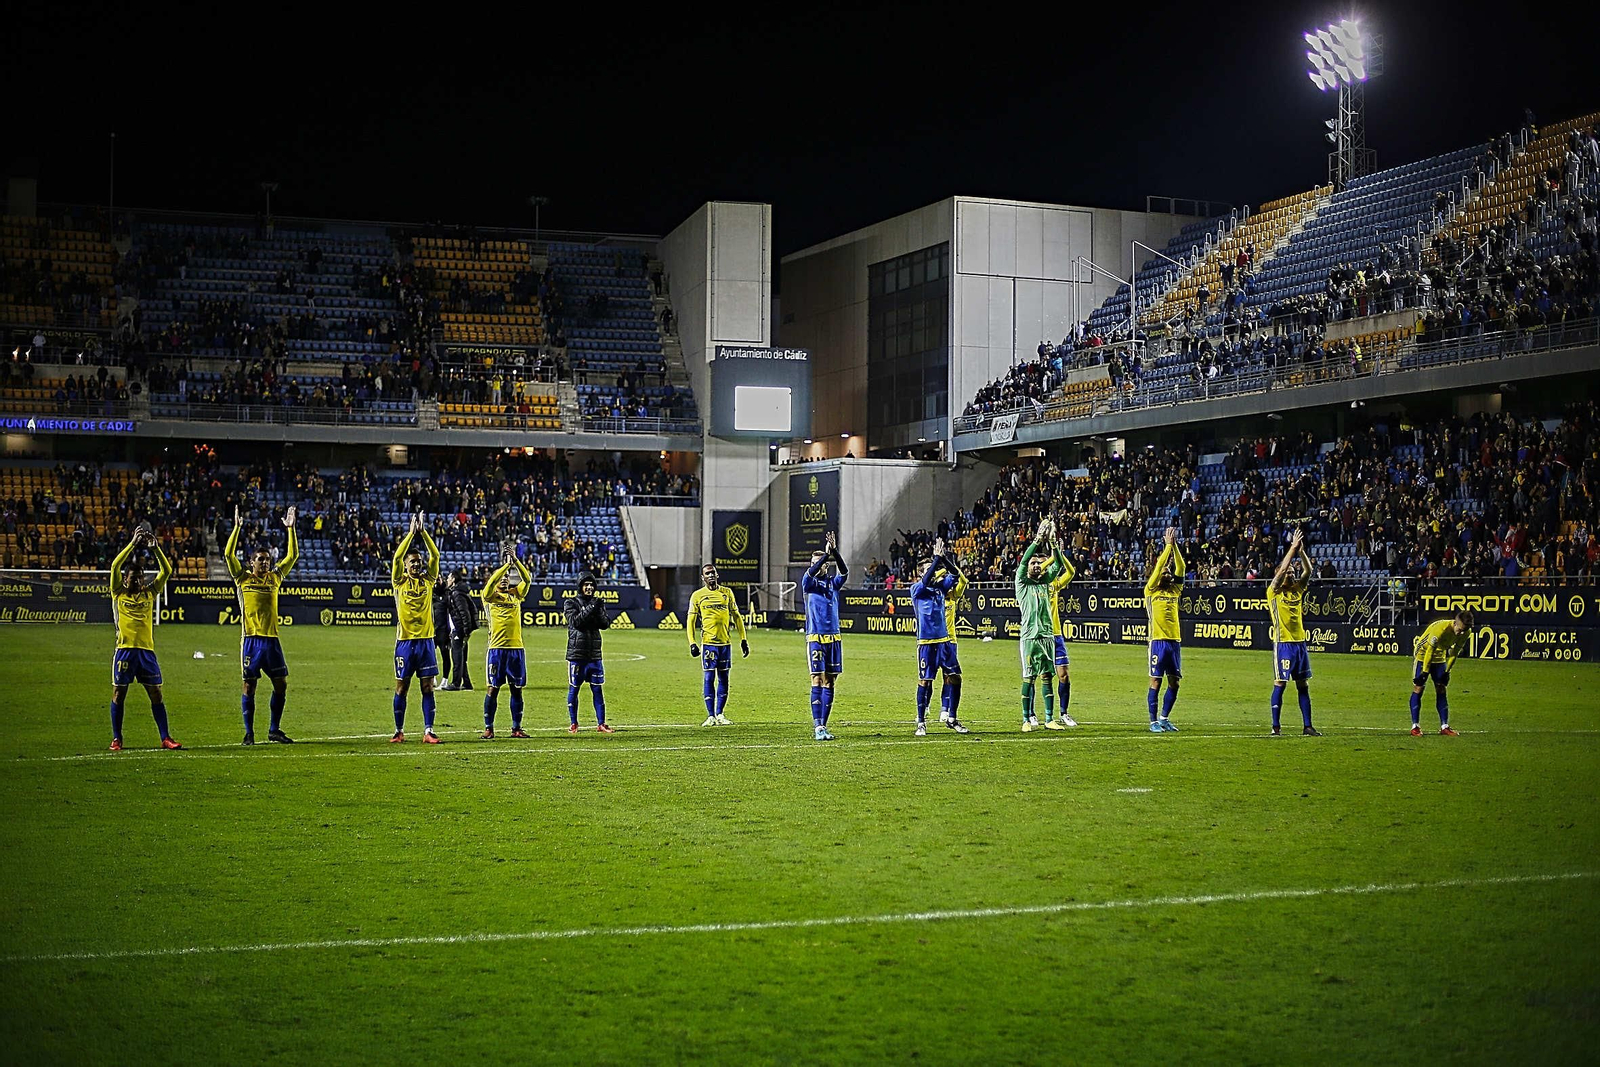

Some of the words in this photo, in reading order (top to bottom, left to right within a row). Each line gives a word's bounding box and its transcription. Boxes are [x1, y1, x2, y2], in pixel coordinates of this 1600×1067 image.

[720, 348, 772, 360] Ayuntamiento
[773, 350, 783, 359] de
[82, 420, 96, 430] DE
[800, 504, 828, 522] TOBBA
[174, 586, 235, 594] ALMADRABA
[845, 597, 884, 605] TORROT.COM
[990, 598, 1020, 608] TORRO
[1232, 599, 1270, 610] TORR
[1421, 594, 1557, 613] TORROT.COM
[15, 605, 87, 624] Menorquina
[336, 610, 366, 619] PETACA
[366, 610, 392, 619] CHICO
[867, 617, 893, 632] TOYOTA
[896, 618, 917, 632] GAMO
[1063, 620, 1110, 640] TOLIMPS
[1122, 625, 1132, 635] LA
[1132, 625, 1146, 636] VOZ
[1194, 623, 1252, 639] EUROPEA
[1353, 625, 1379, 638] CÁDIZ
[1381, 628, 1395, 638] C.F.
[1525, 629, 1557, 644] CÁDIZ
[1560, 632, 1577, 644] C.F.
[244, 656, 251, 667] 5
[396, 656, 404, 668] 15
[920, 658, 926, 668] 6
[1152, 654, 1158, 665] 3
[1281, 659, 1290, 670] 18
[116, 660, 129, 672] 19
